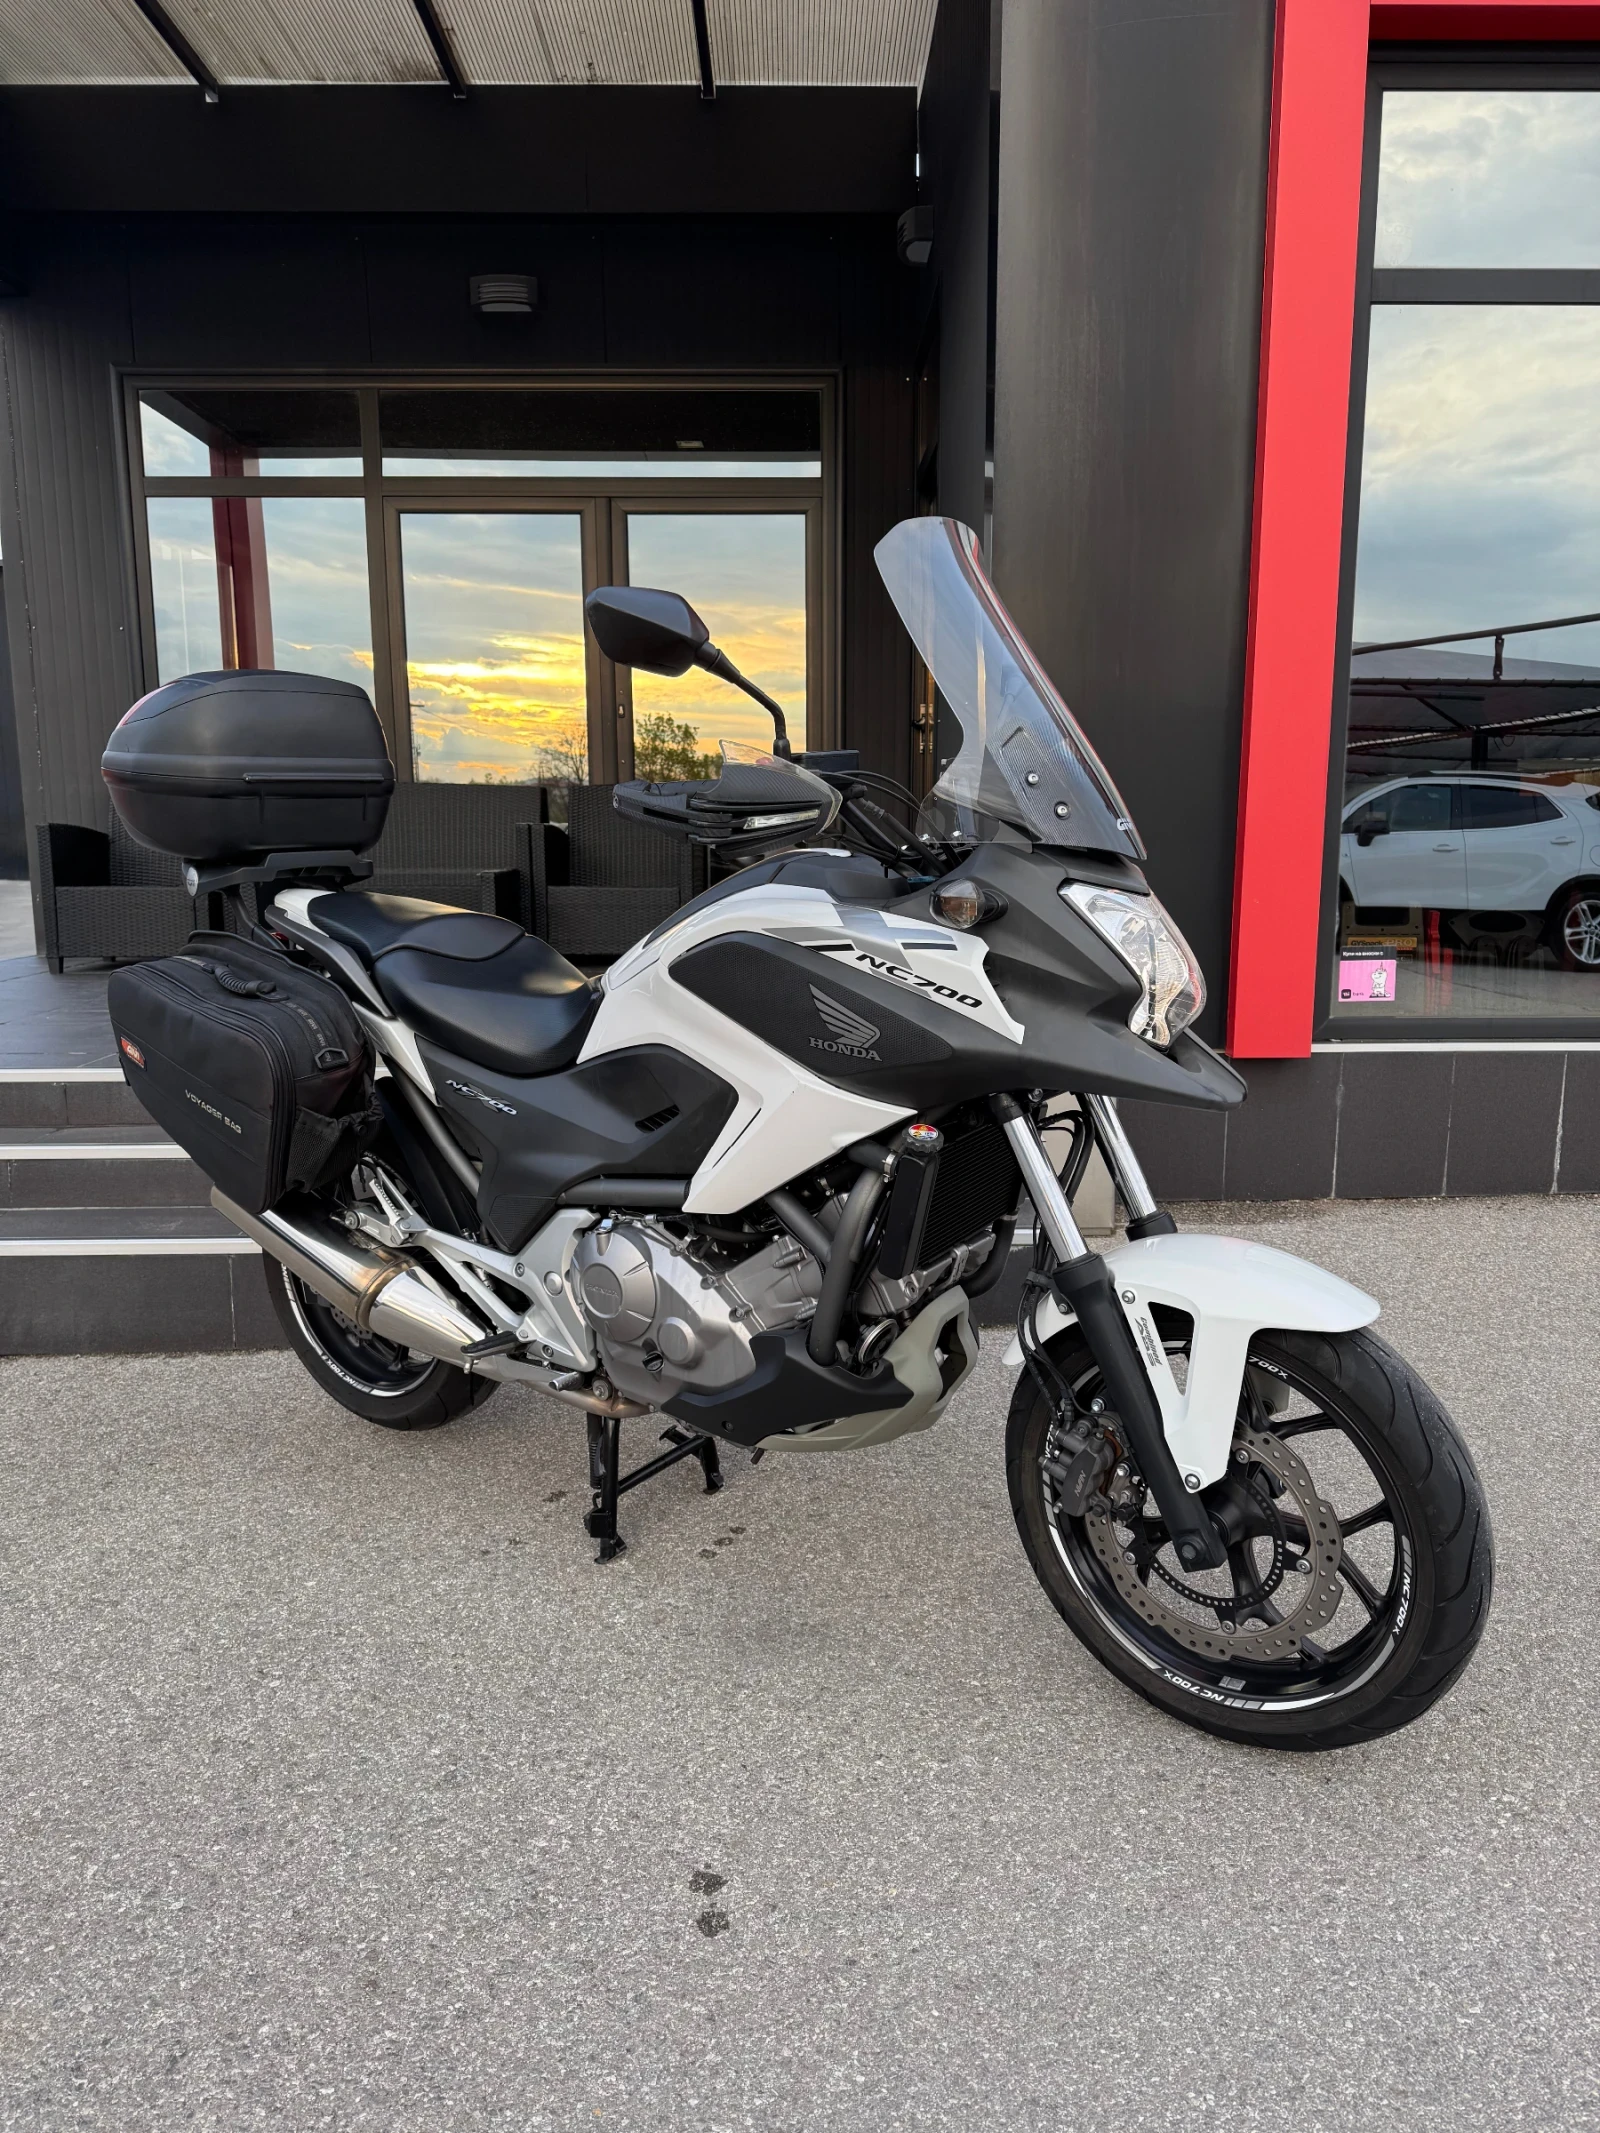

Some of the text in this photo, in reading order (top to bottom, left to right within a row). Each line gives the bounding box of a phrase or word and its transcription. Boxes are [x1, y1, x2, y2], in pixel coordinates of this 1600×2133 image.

[855, 953, 983, 1009] NC700
[808, 1036, 882, 1062] HONDA
[184, 1089, 242, 1134] VOYAGER BAG
[1247, 1355, 1289, 1380] 700X
[1392, 1571, 1411, 1636] NC700X
[1163, 1669, 1225, 1702] NC700X
